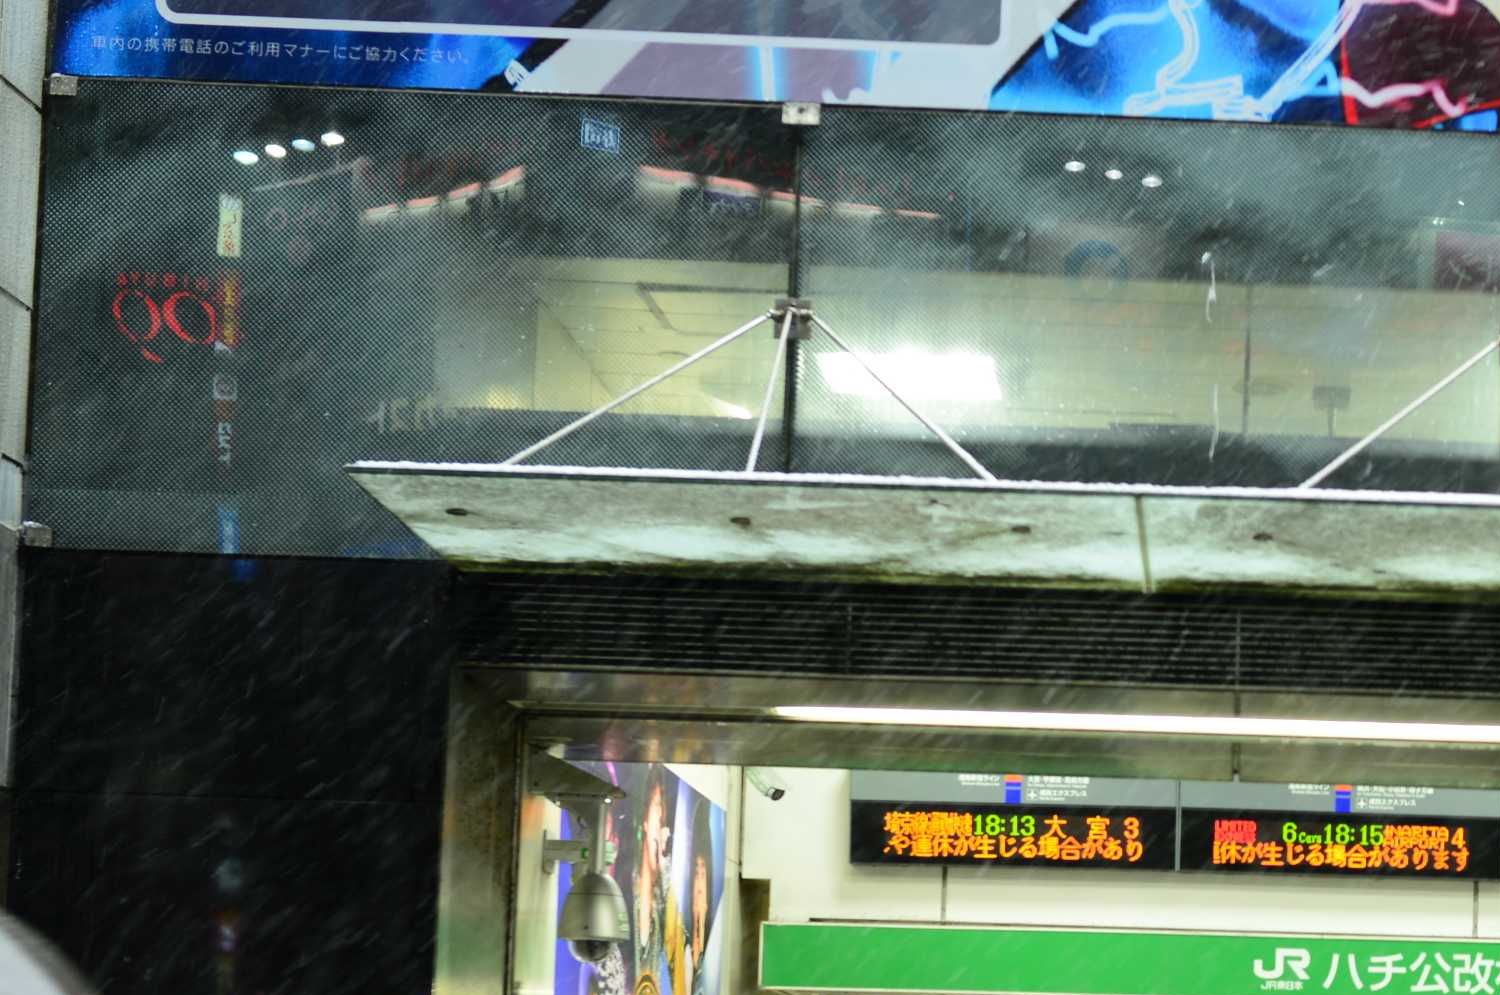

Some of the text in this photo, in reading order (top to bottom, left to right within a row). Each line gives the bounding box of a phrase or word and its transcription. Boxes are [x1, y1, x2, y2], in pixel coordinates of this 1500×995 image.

[974, 814, 1036, 836] 18:13
[1123, 817, 1140, 838] 3
[1282, 822, 1297, 843] 6
[1323, 823, 1384, 845] 18:15
[1451, 827, 1466, 849] 4
[1253, 947, 1311, 980] JR
